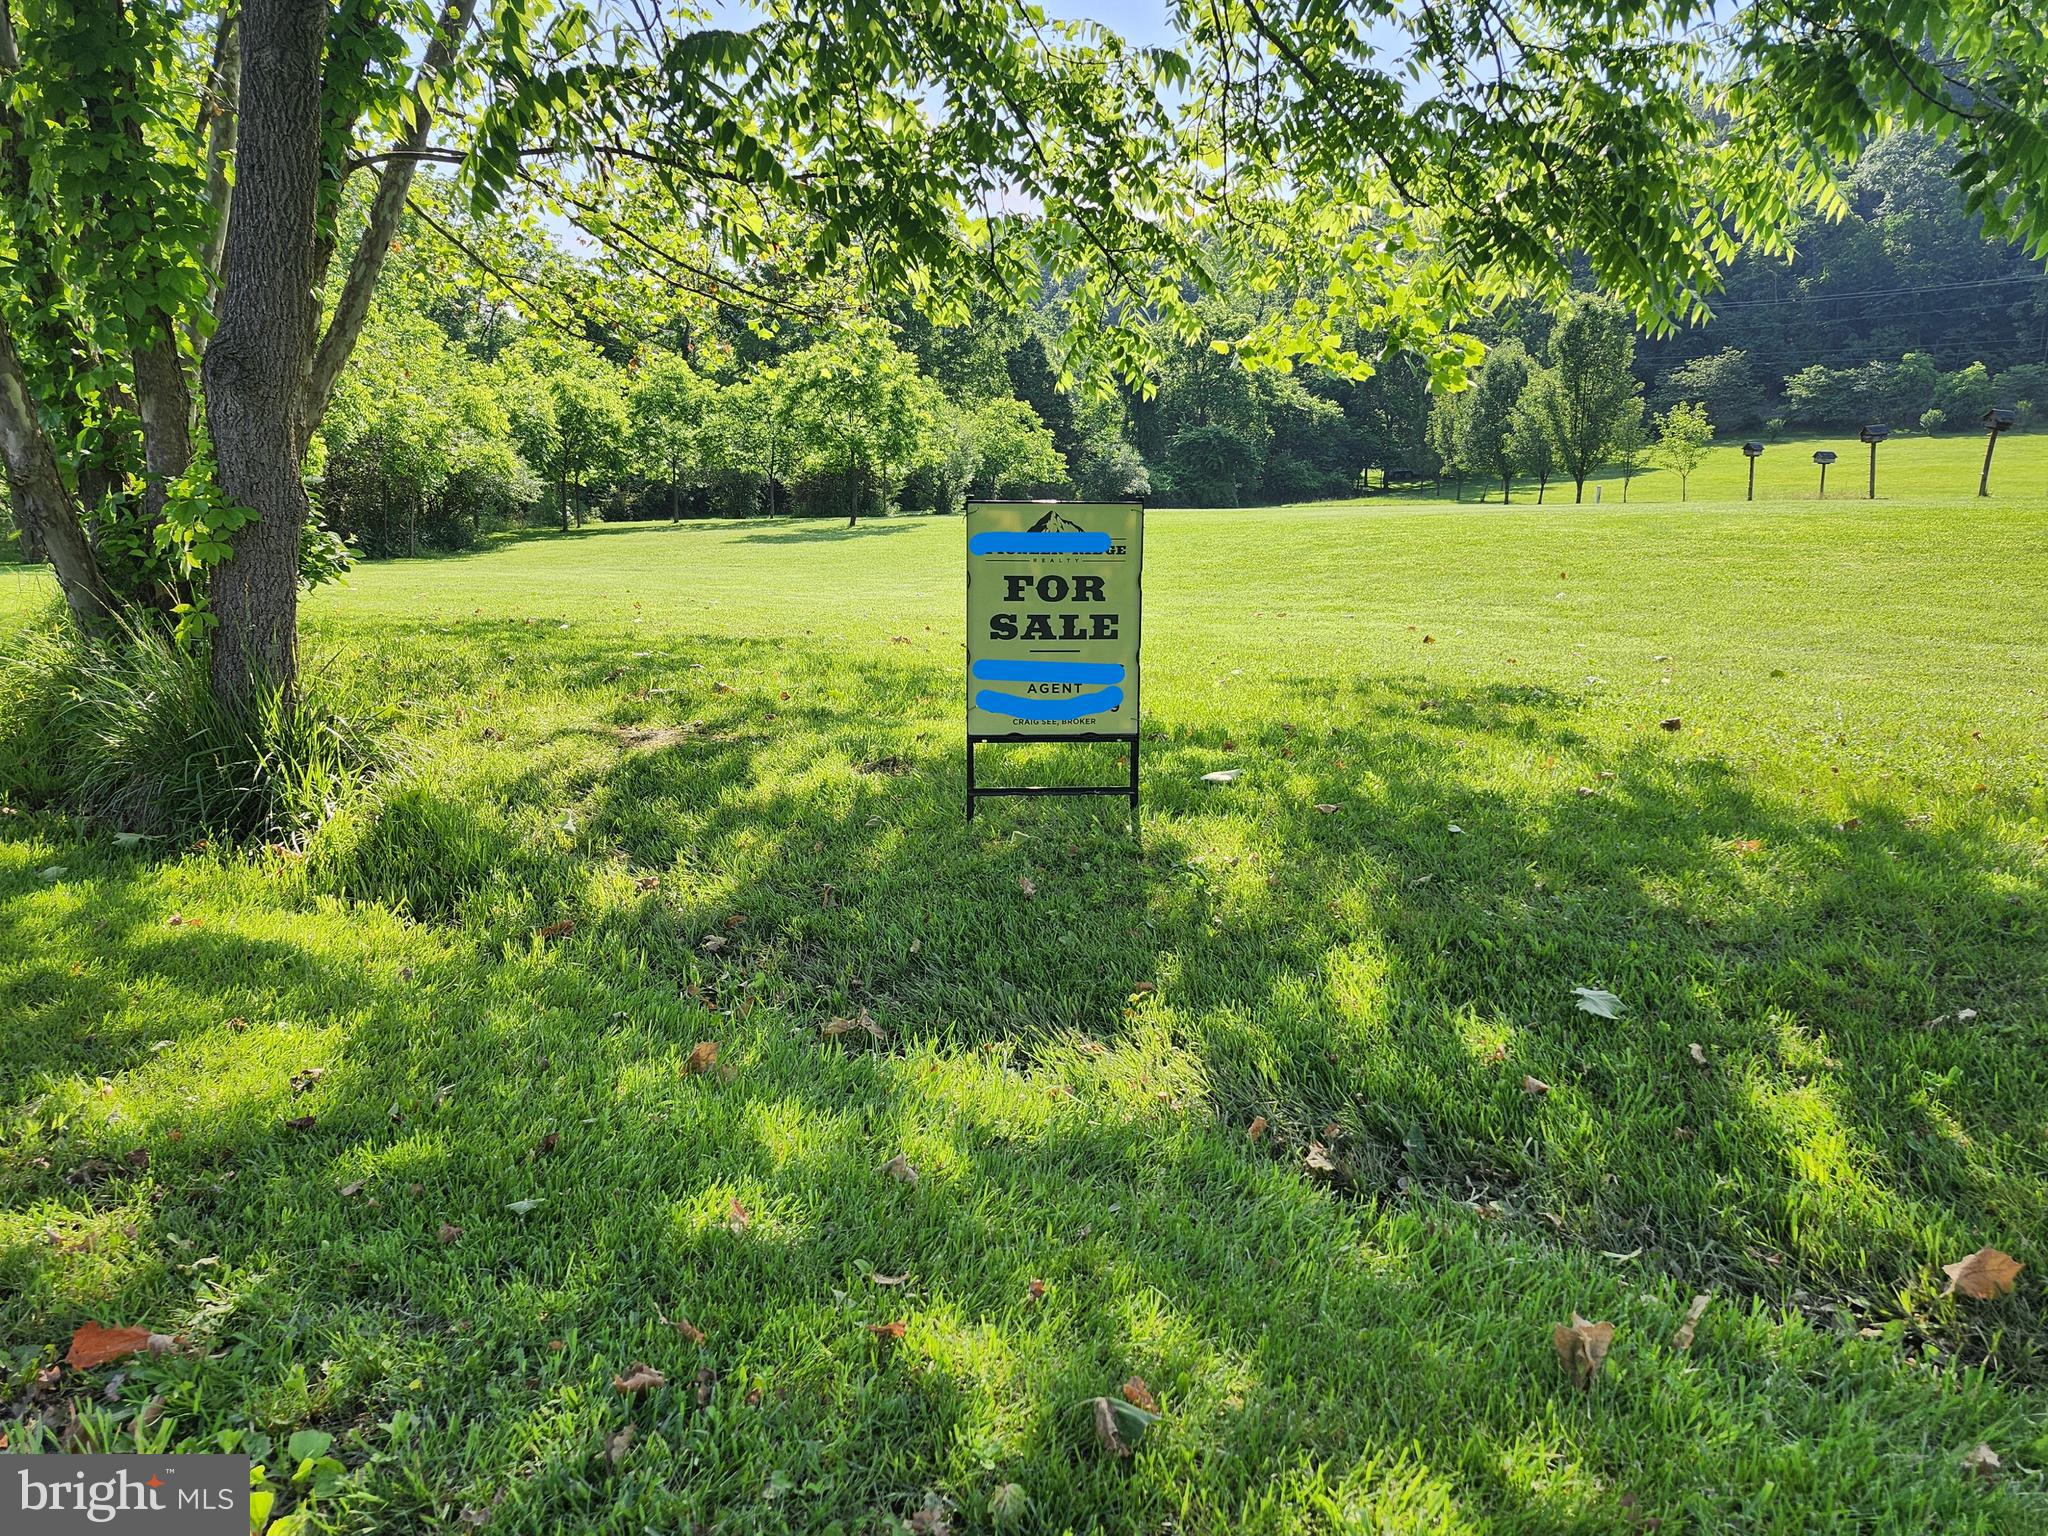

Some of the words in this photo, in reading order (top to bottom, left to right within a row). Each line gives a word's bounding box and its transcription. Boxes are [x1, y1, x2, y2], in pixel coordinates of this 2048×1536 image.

[1003, 575, 1106, 602] FOR
[989, 613, 1119, 640] SALE
[1027, 683, 1083, 694] AGENT
